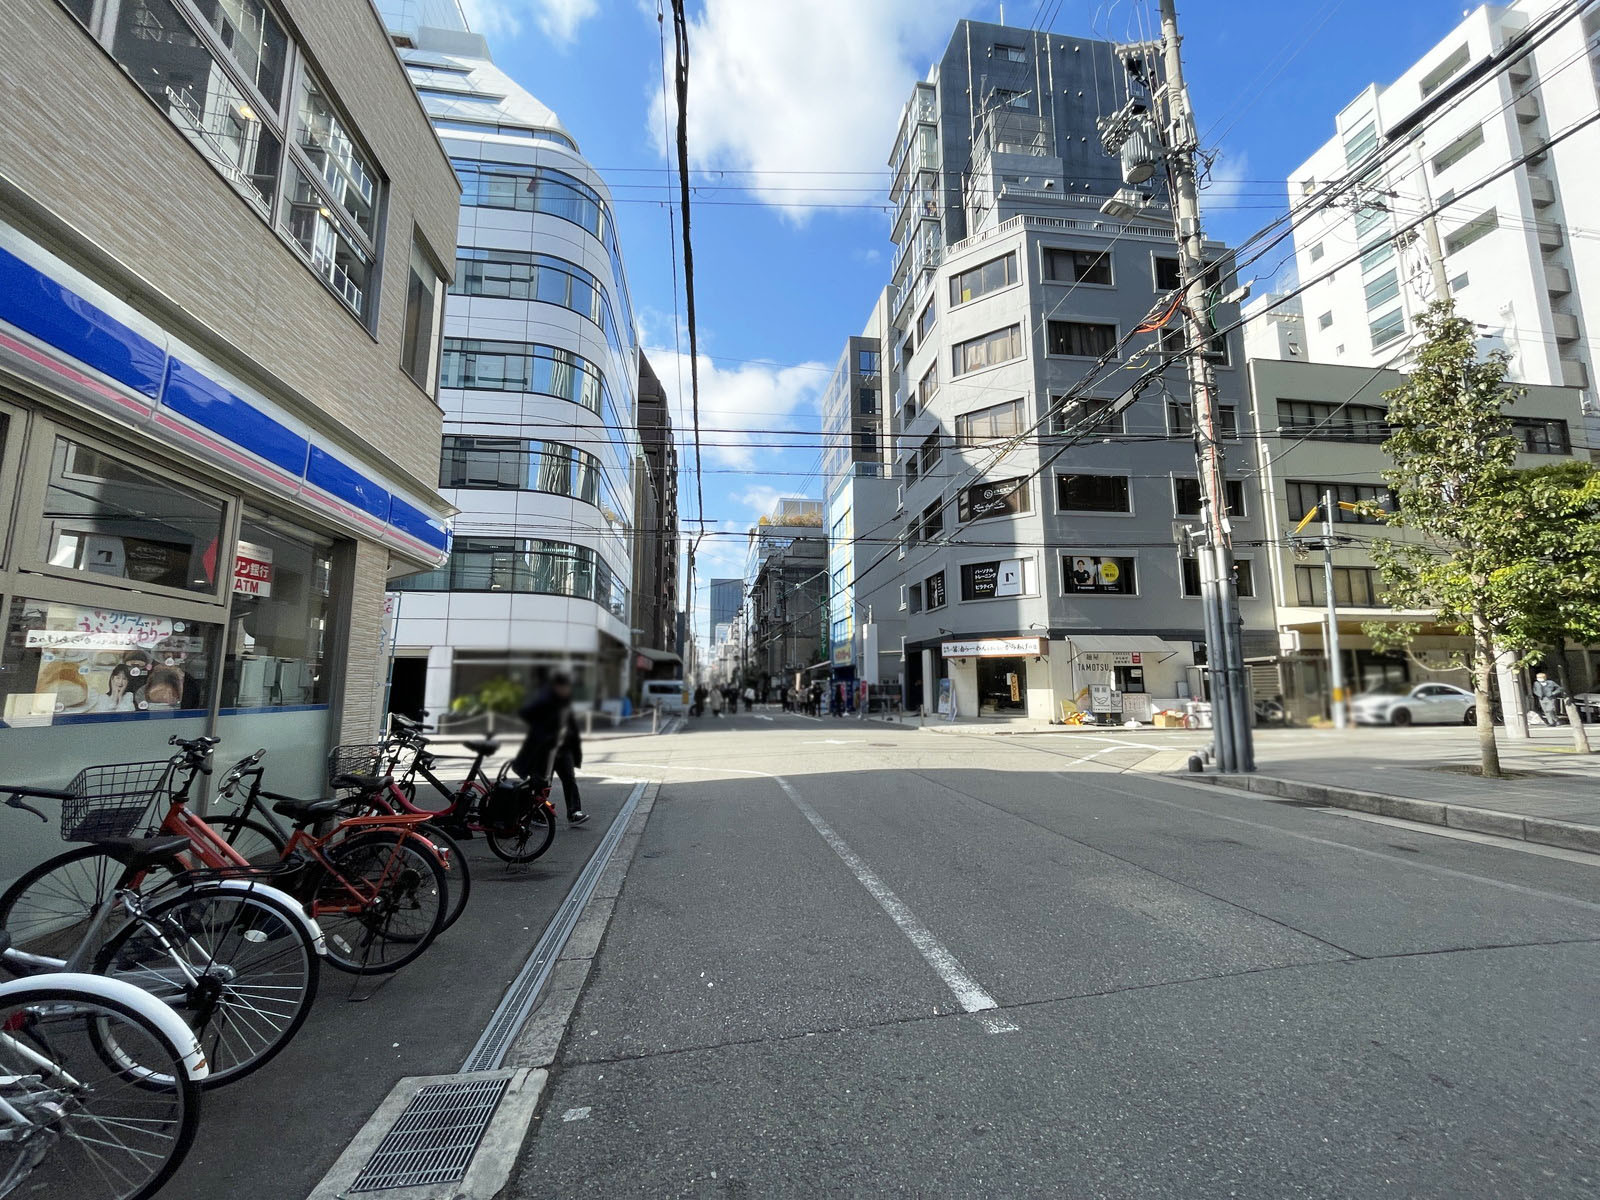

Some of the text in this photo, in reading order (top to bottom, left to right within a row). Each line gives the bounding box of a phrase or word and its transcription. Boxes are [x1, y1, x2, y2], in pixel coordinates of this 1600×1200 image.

[974, 572, 997, 580] トレーニング
[234, 579, 259, 593] ATM
